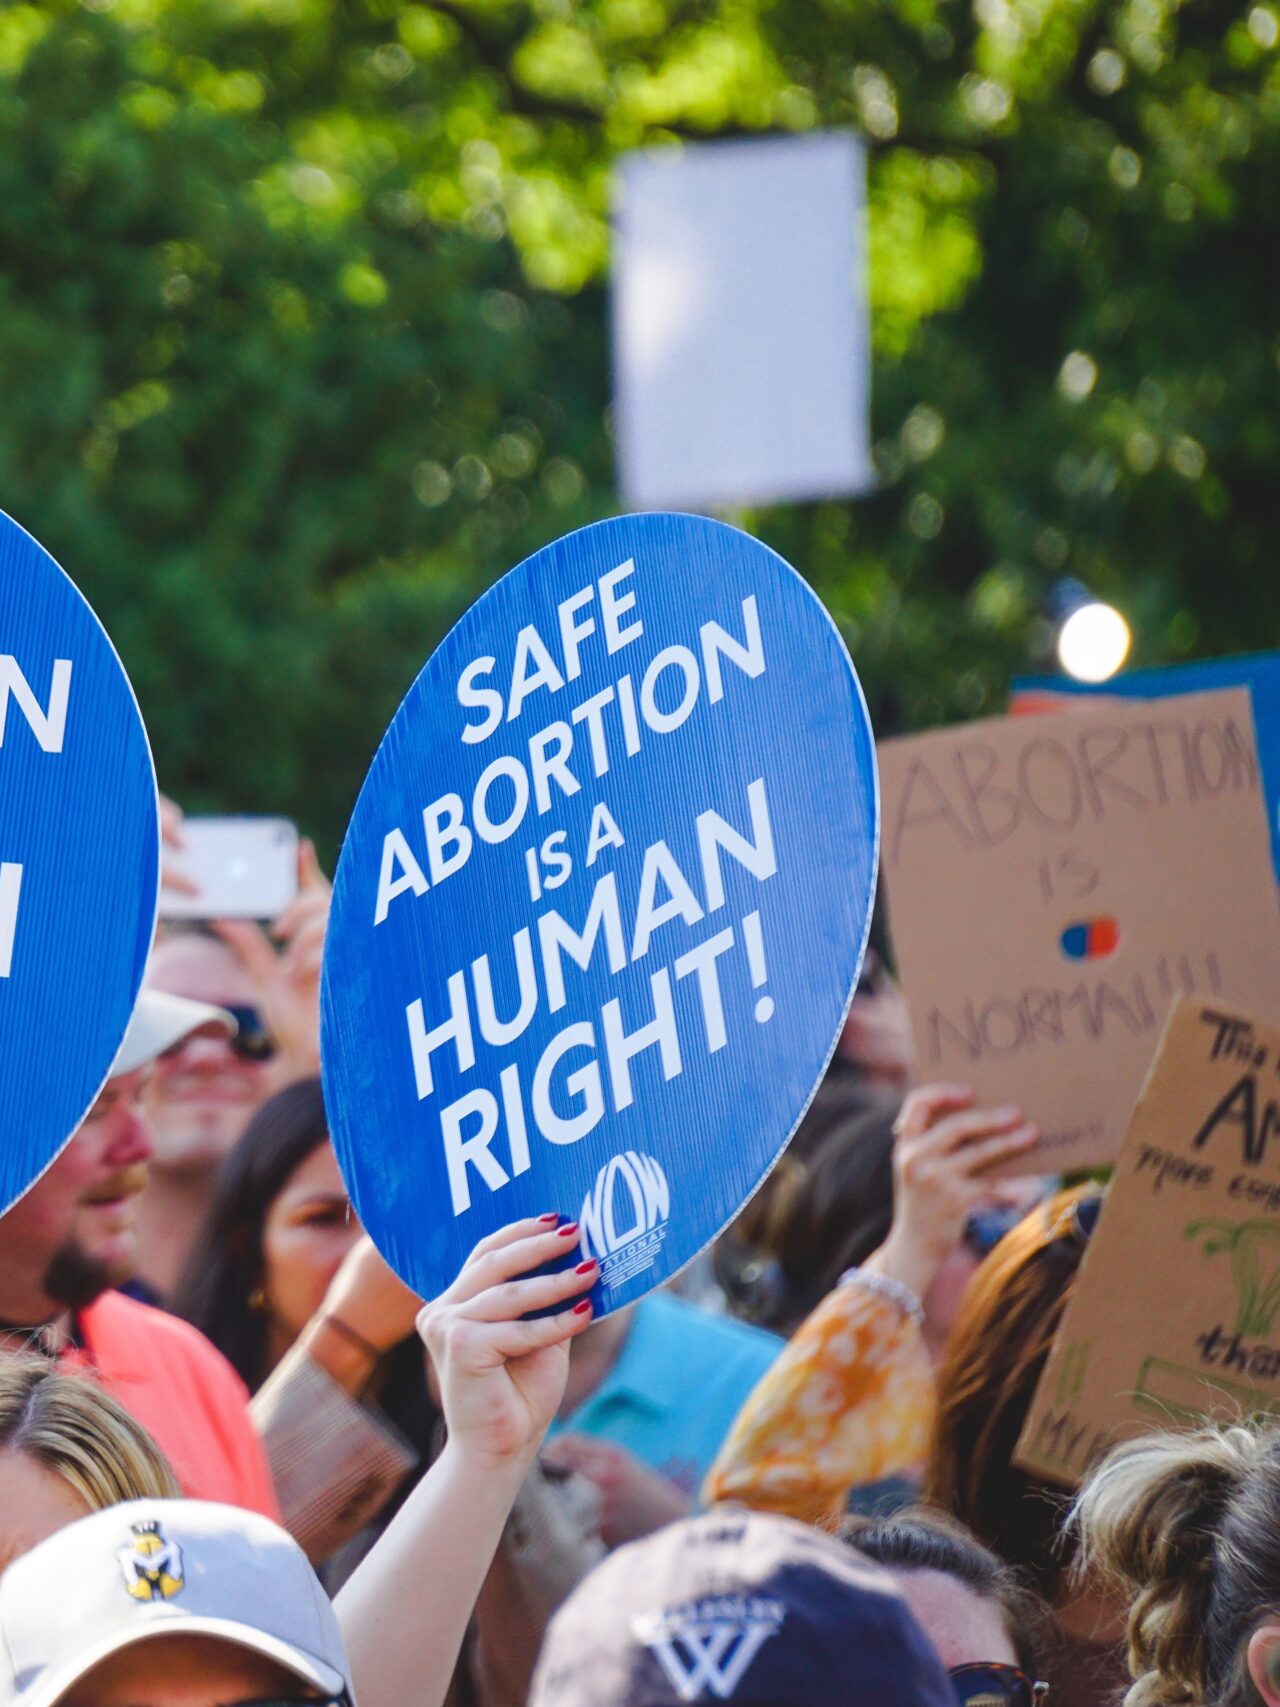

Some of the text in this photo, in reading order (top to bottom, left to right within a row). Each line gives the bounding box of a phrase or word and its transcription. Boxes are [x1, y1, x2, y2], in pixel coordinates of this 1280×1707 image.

[458, 559, 643, 743] SAFE
[375, 595, 766, 925] ABORTION
[890, 716, 1260, 867] ABORTION
[526, 802, 625, 902] IS A
[1038, 848, 1101, 902] IS
[407, 778, 777, 1099] HUMAN
[441, 910, 774, 1216] RIGHT!
[604, 1228, 666, 1271] ATIONAL
